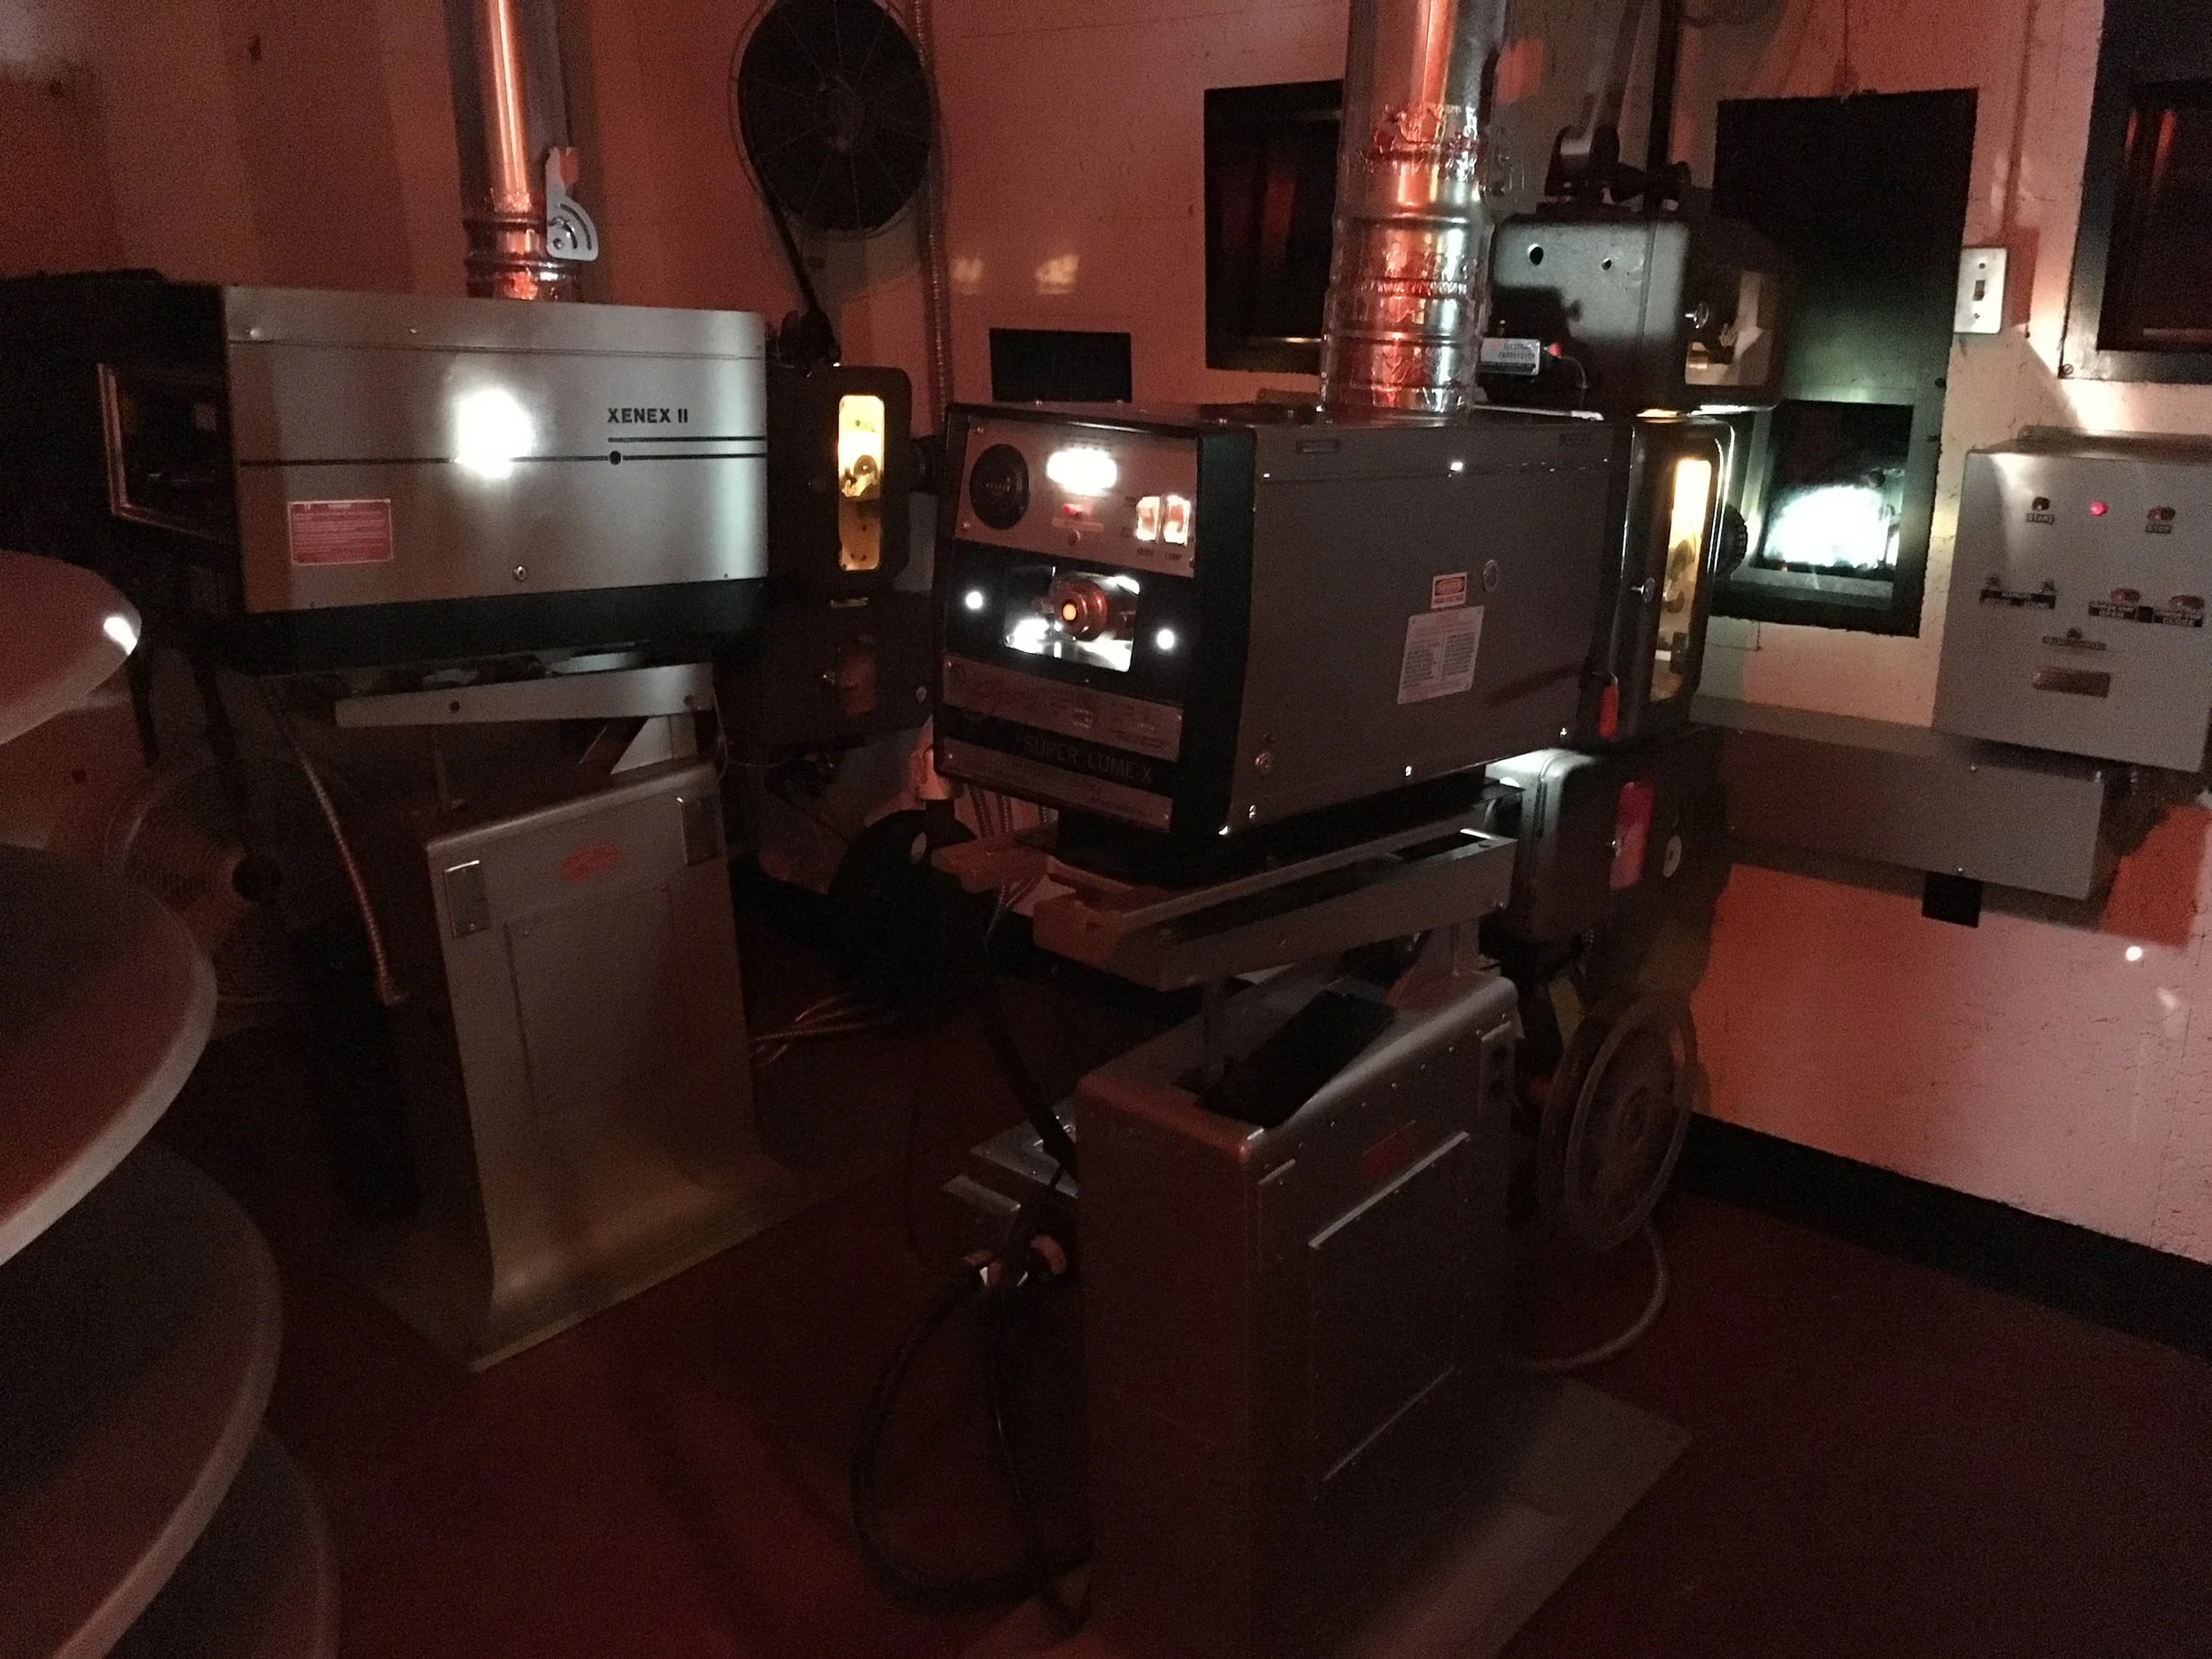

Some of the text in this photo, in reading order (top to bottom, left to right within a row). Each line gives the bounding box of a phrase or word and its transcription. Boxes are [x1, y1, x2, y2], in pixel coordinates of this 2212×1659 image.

[607, 408, 688, 423] XENEX II
[1023, 735, 1079, 764] SUPER
